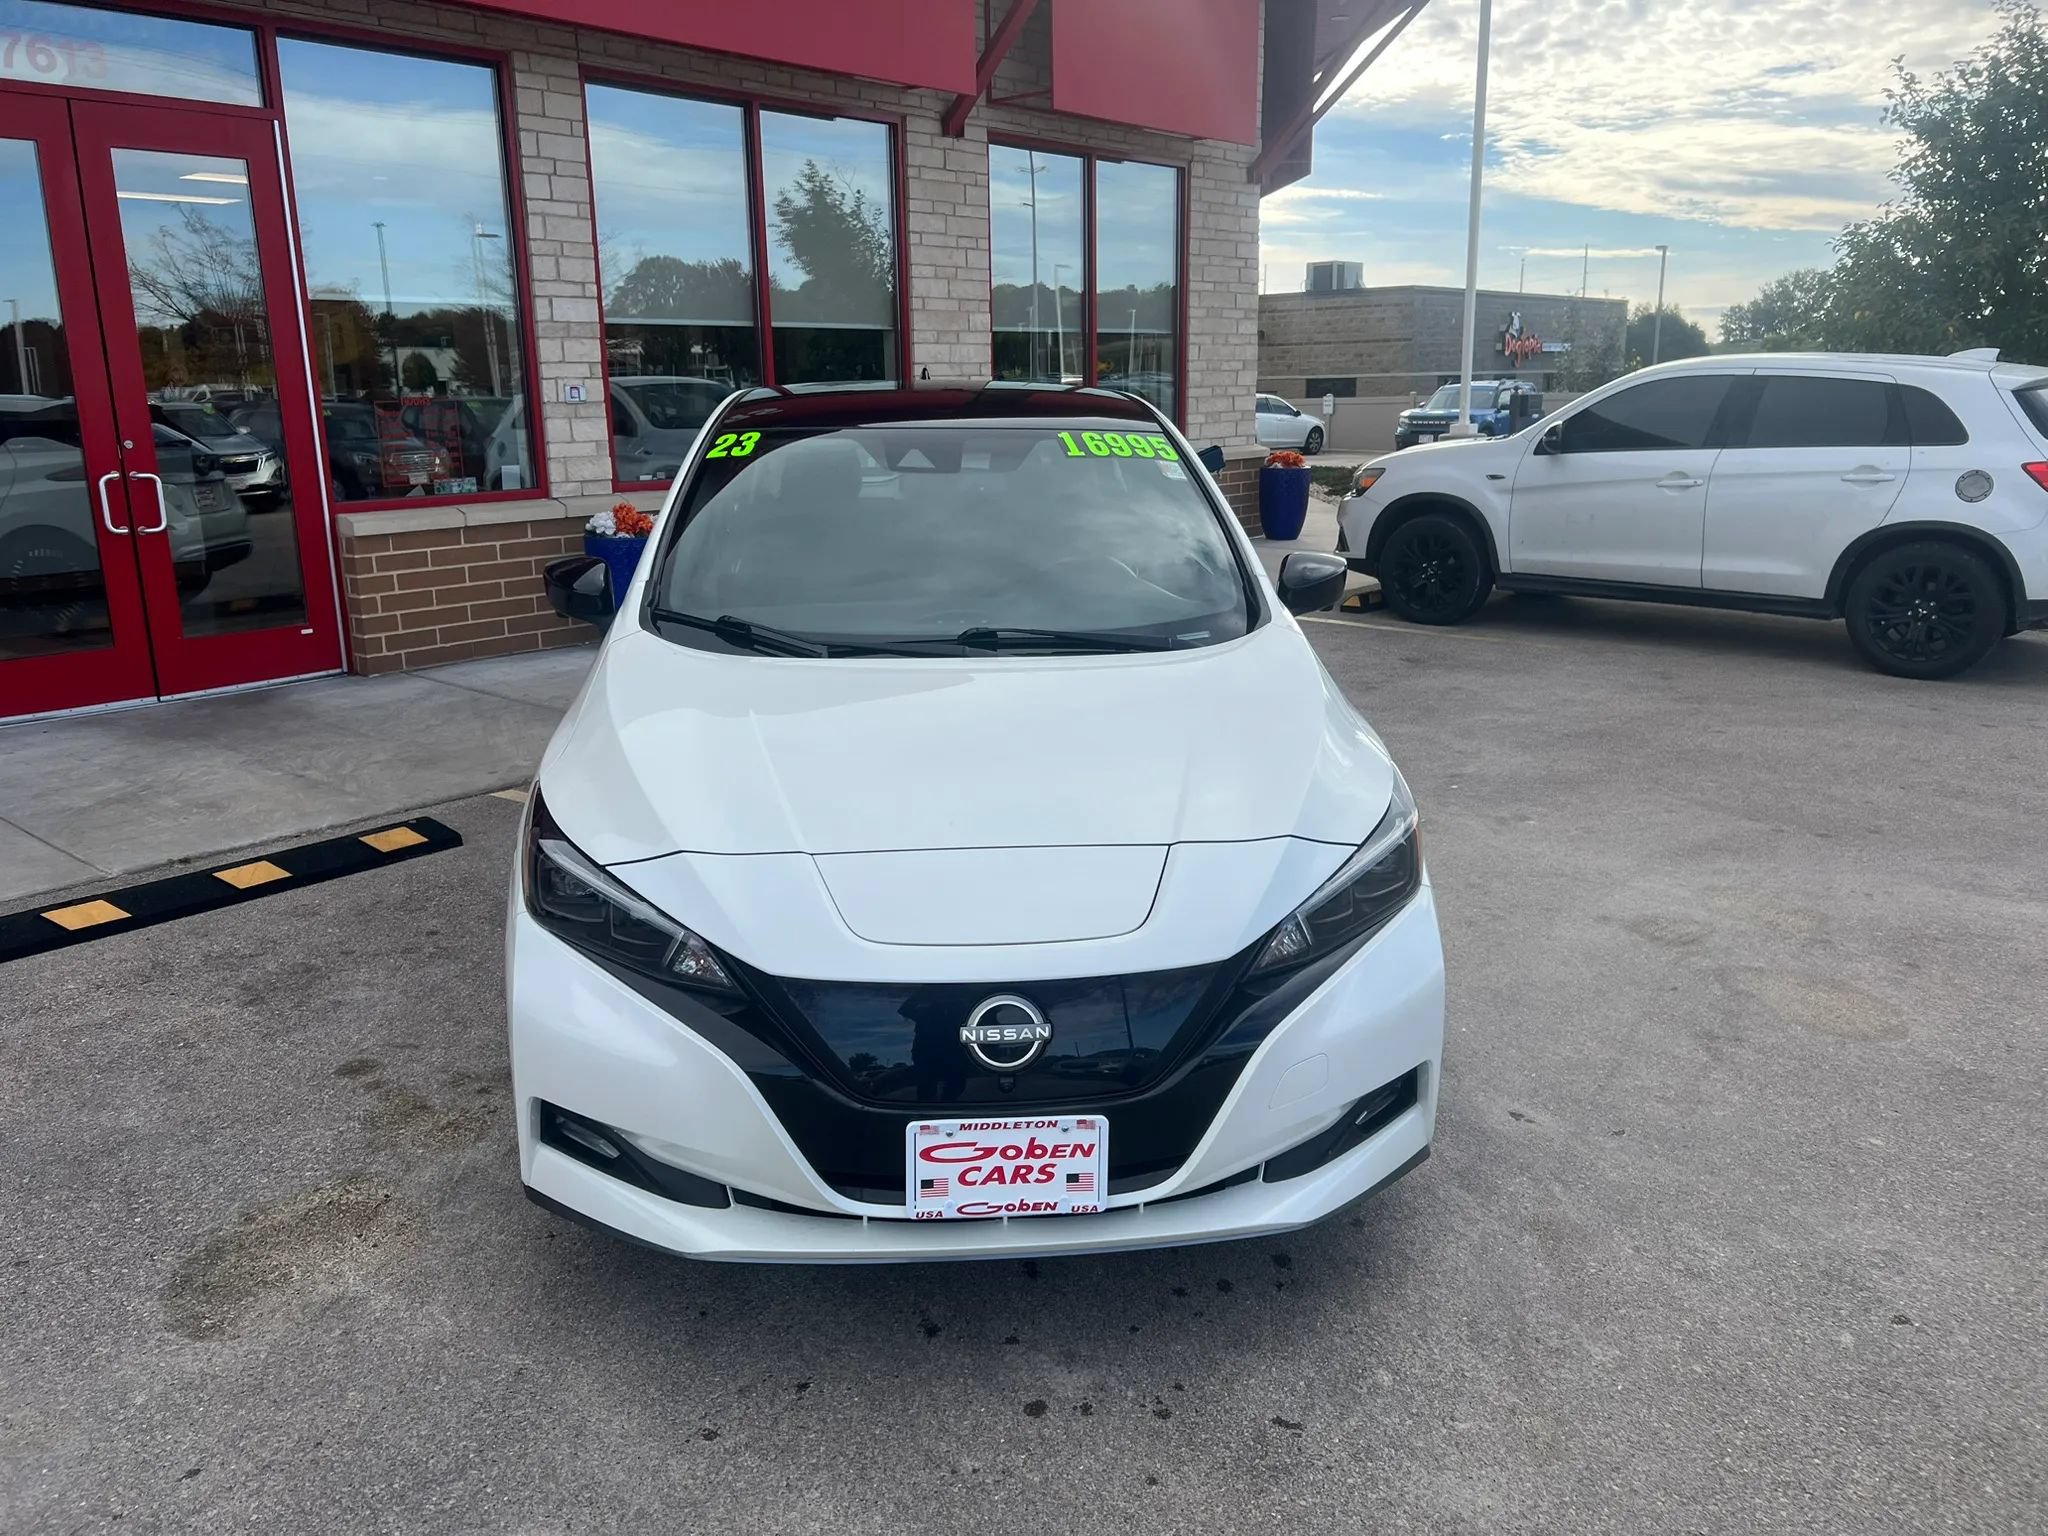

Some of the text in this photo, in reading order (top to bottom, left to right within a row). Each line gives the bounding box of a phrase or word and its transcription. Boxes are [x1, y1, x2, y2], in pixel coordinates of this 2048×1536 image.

[705, 431, 761, 459] 23
[1057, 431, 1179, 461] 16995
[961, 1026, 1049, 1041] NISSAN
[958, 1119, 1059, 1132] MIDDLETON
[957, 1163, 1058, 1187] CARS
[915, 1210, 944, 1219] USA
[1071, 1204, 1099, 1213] USA
